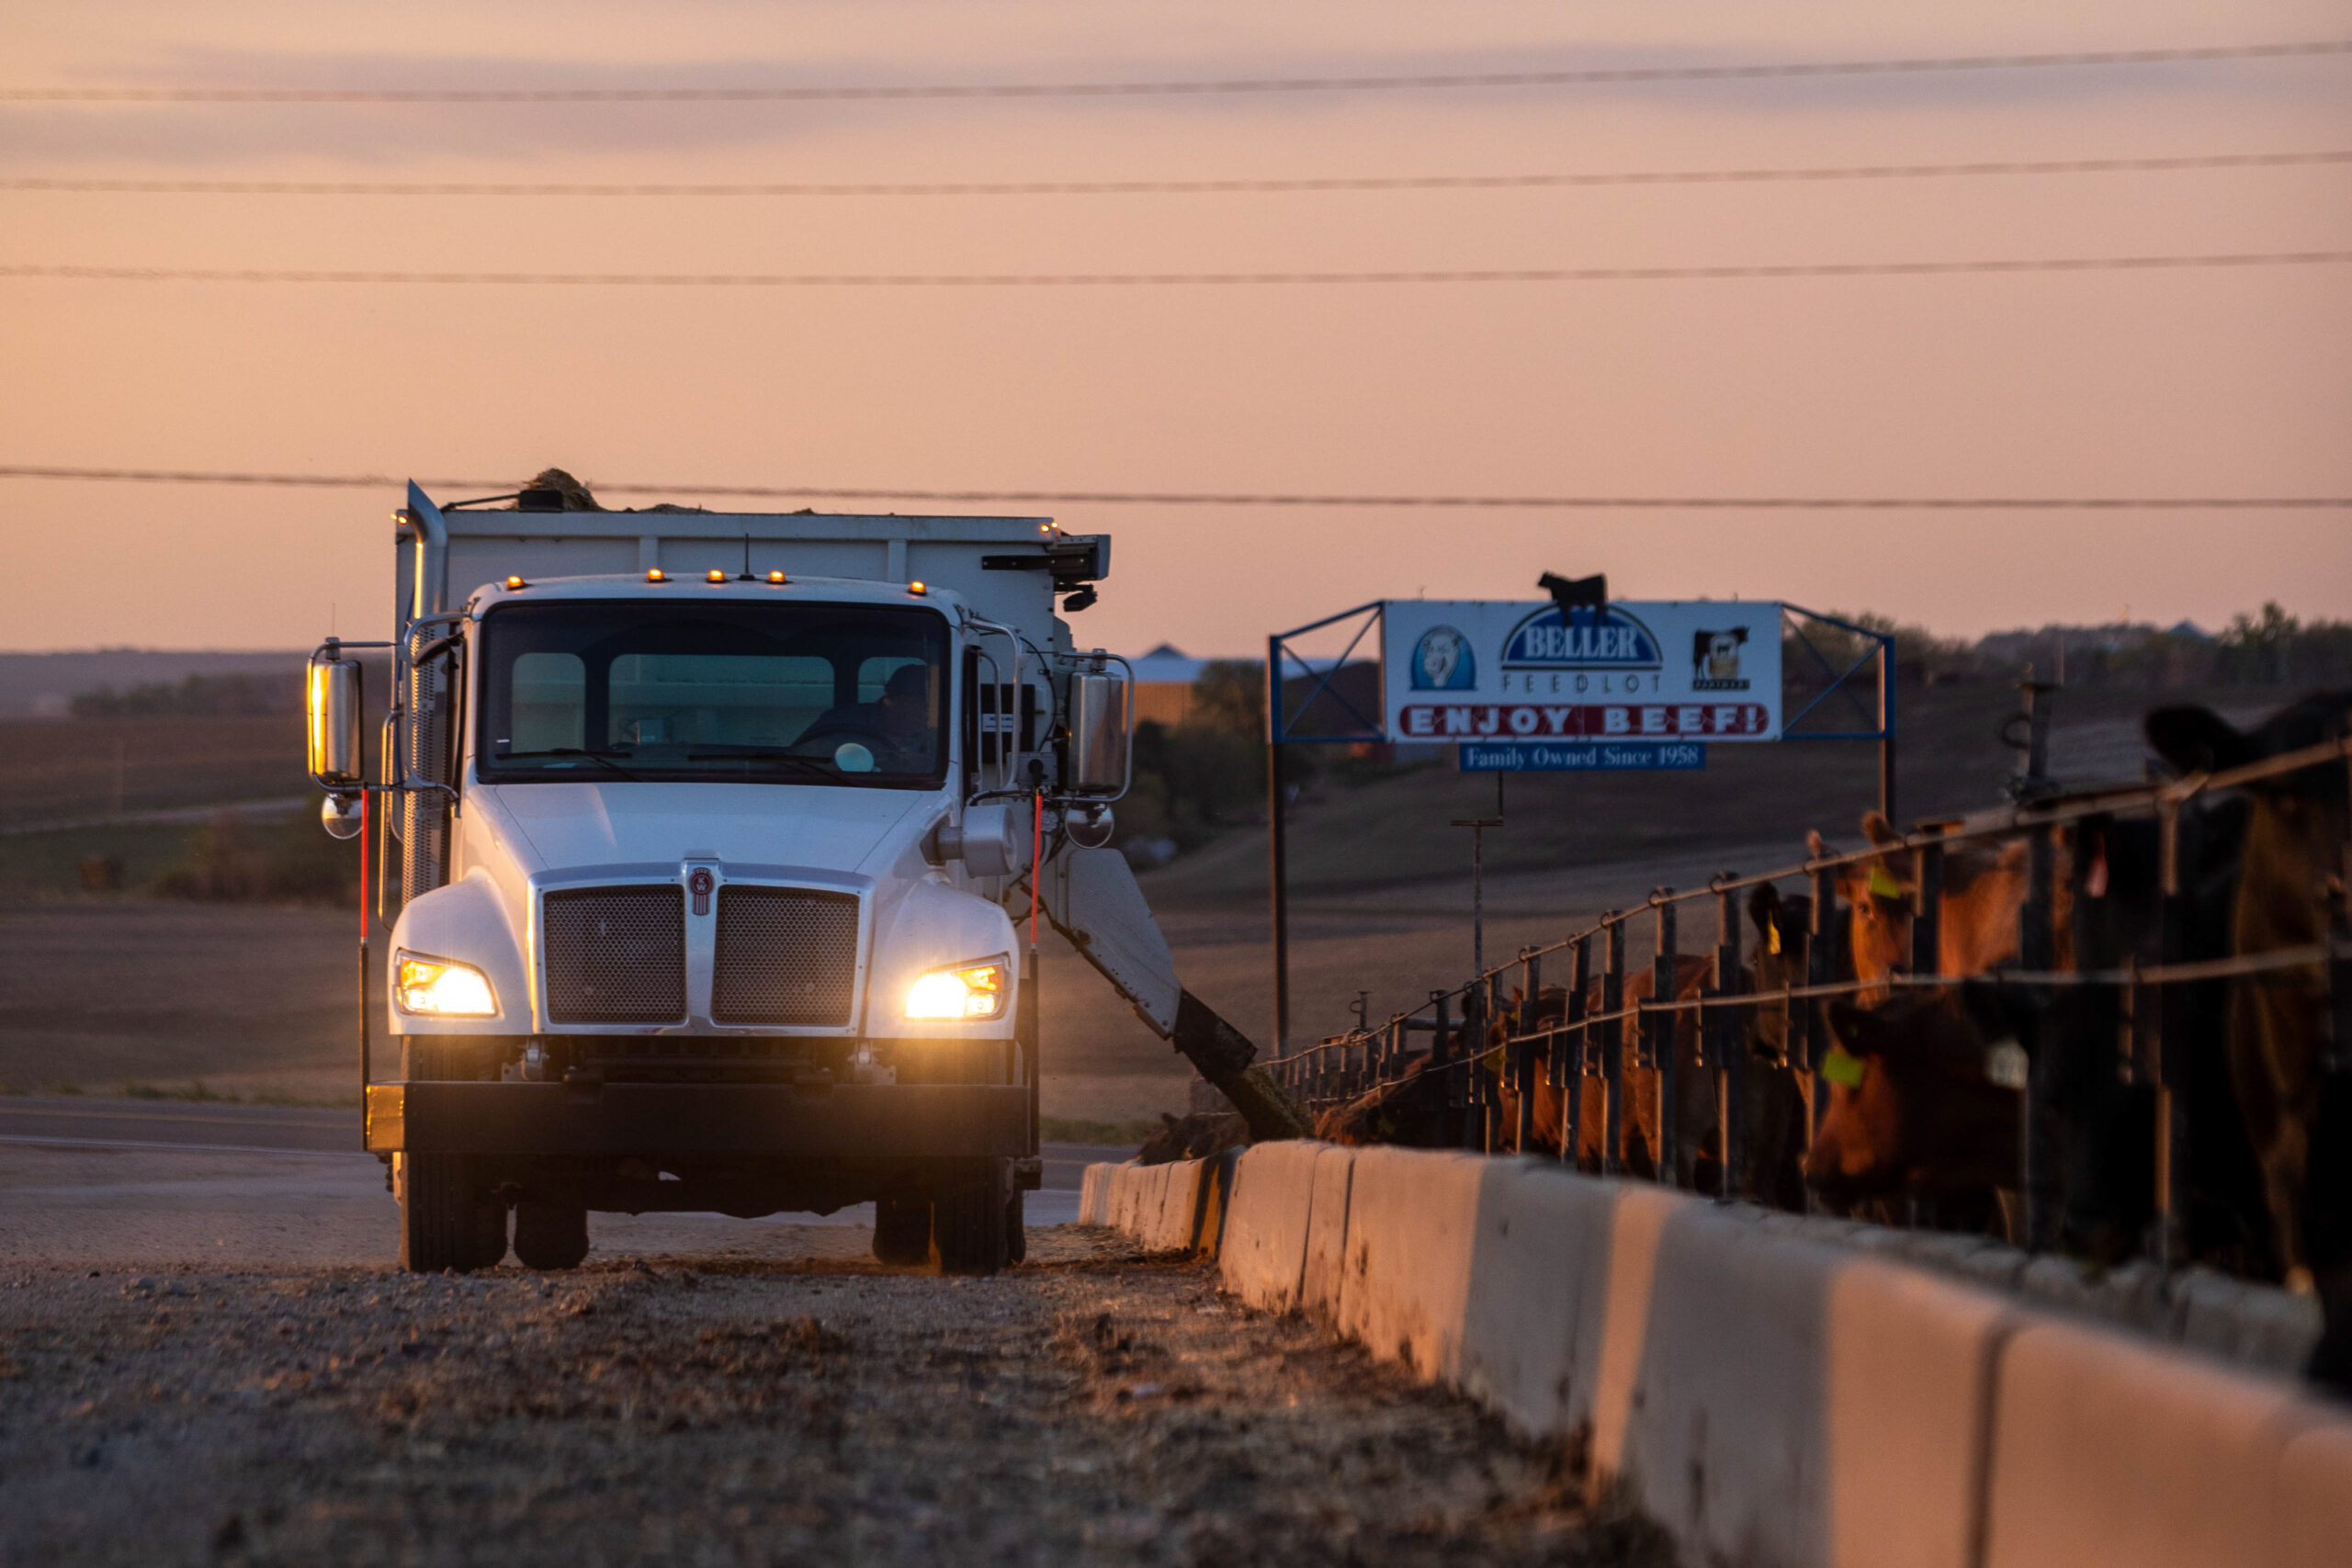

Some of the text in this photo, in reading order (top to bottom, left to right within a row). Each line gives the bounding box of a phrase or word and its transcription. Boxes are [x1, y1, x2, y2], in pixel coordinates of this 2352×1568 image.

[1525, 626, 1639, 659] BELLER
[1502, 674, 1660, 694] FEEDLOT
[1409, 705, 1758, 734] ENJOY BEEF!
[1468, 745, 1699, 771] Family Owned Since 1958
